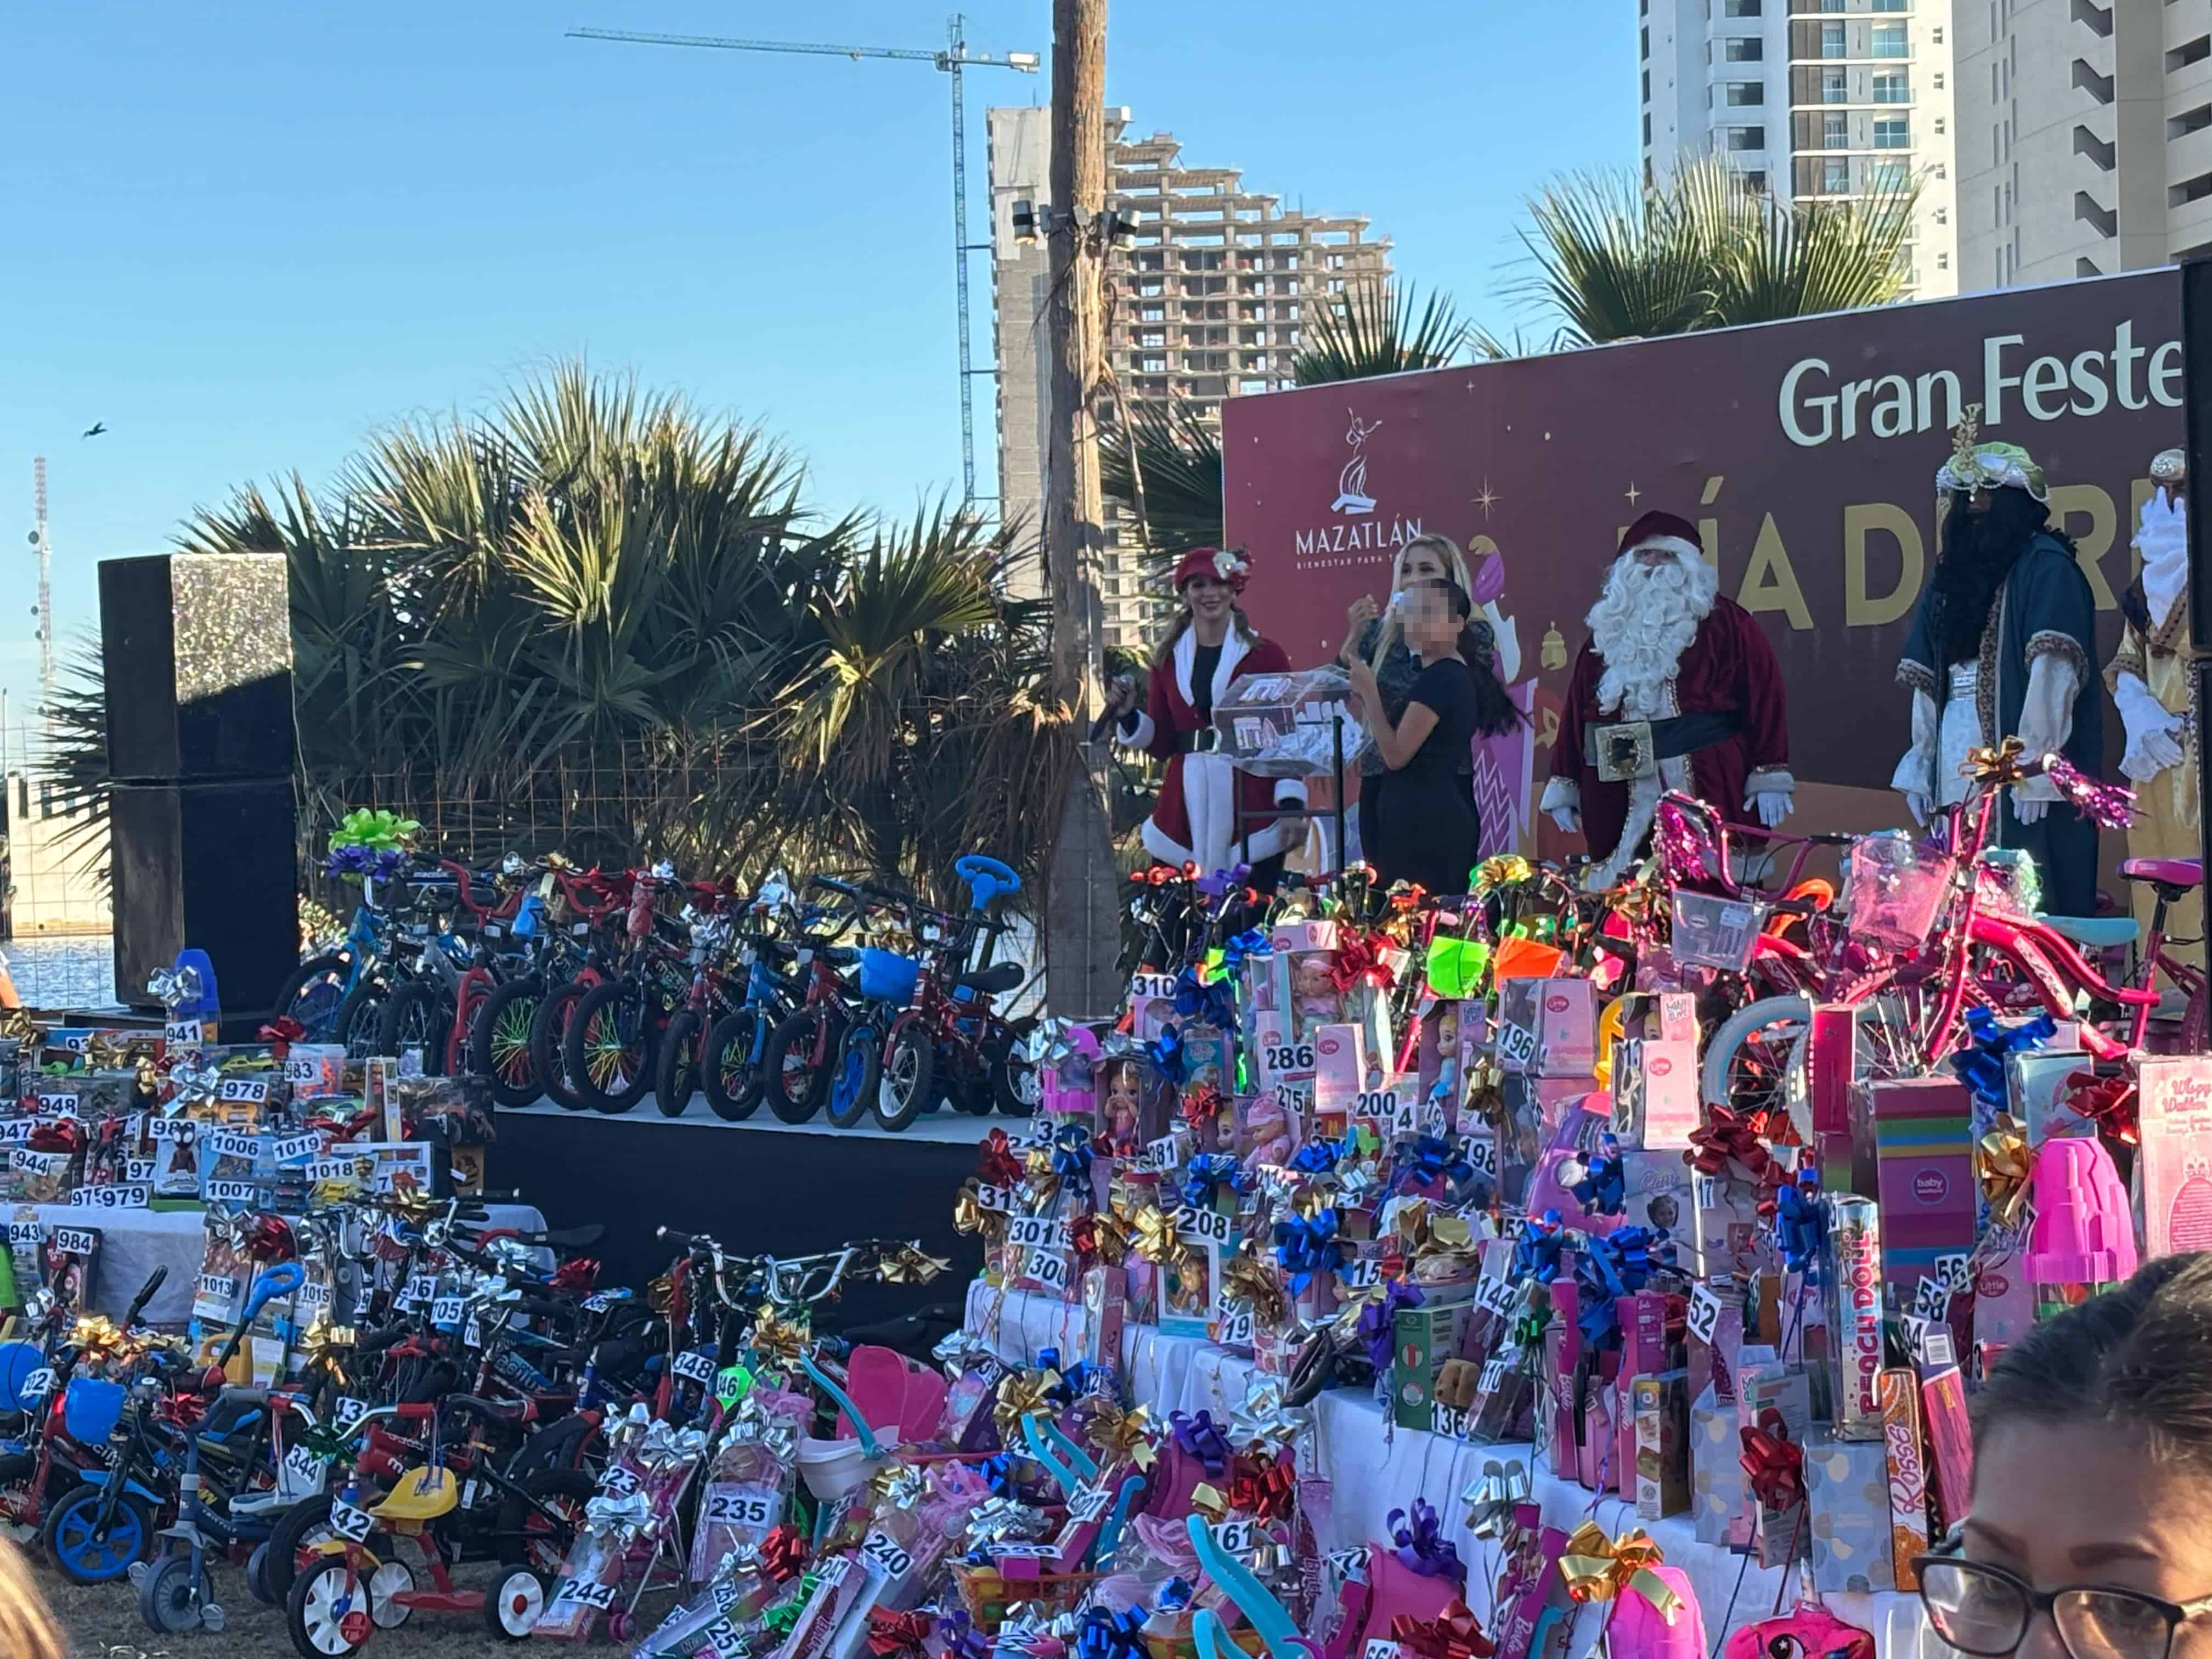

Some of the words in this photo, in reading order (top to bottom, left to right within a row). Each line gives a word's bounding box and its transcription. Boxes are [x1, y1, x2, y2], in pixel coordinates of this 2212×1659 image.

[1779, 358, 1961, 447] Gran
[1295, 513, 1421, 555] MAZATLÁN
[1357, 555, 1383, 565] PARA
[1134, 977, 1174, 997] 310
[167, 1025, 199, 1042] 941
[1503, 1023, 1534, 1060] 196
[1267, 1046, 1314, 1070] 286
[285, 1063, 313, 1078] 983
[226, 1081, 264, 1099] 978
[1278, 1086, 1303, 1113] 275
[40, 1097, 76, 1114] 948
[1357, 1092, 1396, 1116] 200
[215, 1136, 258, 1156] 1006
[275, 1137, 319, 1158] 1019
[1461, 1138, 1496, 1175] 198
[16, 1151, 48, 1173] 944
[309, 1161, 354, 1178] 1018
[208, 1182, 255, 1198] 1007
[1916, 1178, 1943, 1189] baby
[102, 1187, 145, 1207] 979
[10, 1223, 40, 1241] 943
[1011, 1220, 1052, 1243] 301
[1179, 1209, 1227, 1240] 208
[59, 1232, 91, 1252] 984
[1852, 1232, 1874, 1310] DOLL
[203, 1277, 232, 1295] 1013
[302, 1284, 329, 1302] 1015
[1478, 1275, 1515, 1316] 144
[1979, 1280, 2006, 1291] Little
[433, 1300, 460, 1320] 105
[674, 1354, 713, 1380] 348
[1431, 1402, 1468, 1440] 136
[288, 1449, 318, 1483] 344
[710, 1497, 766, 1522] 235
[864, 1534, 912, 1575] 240
[560, 1579, 612, 1606] 244
